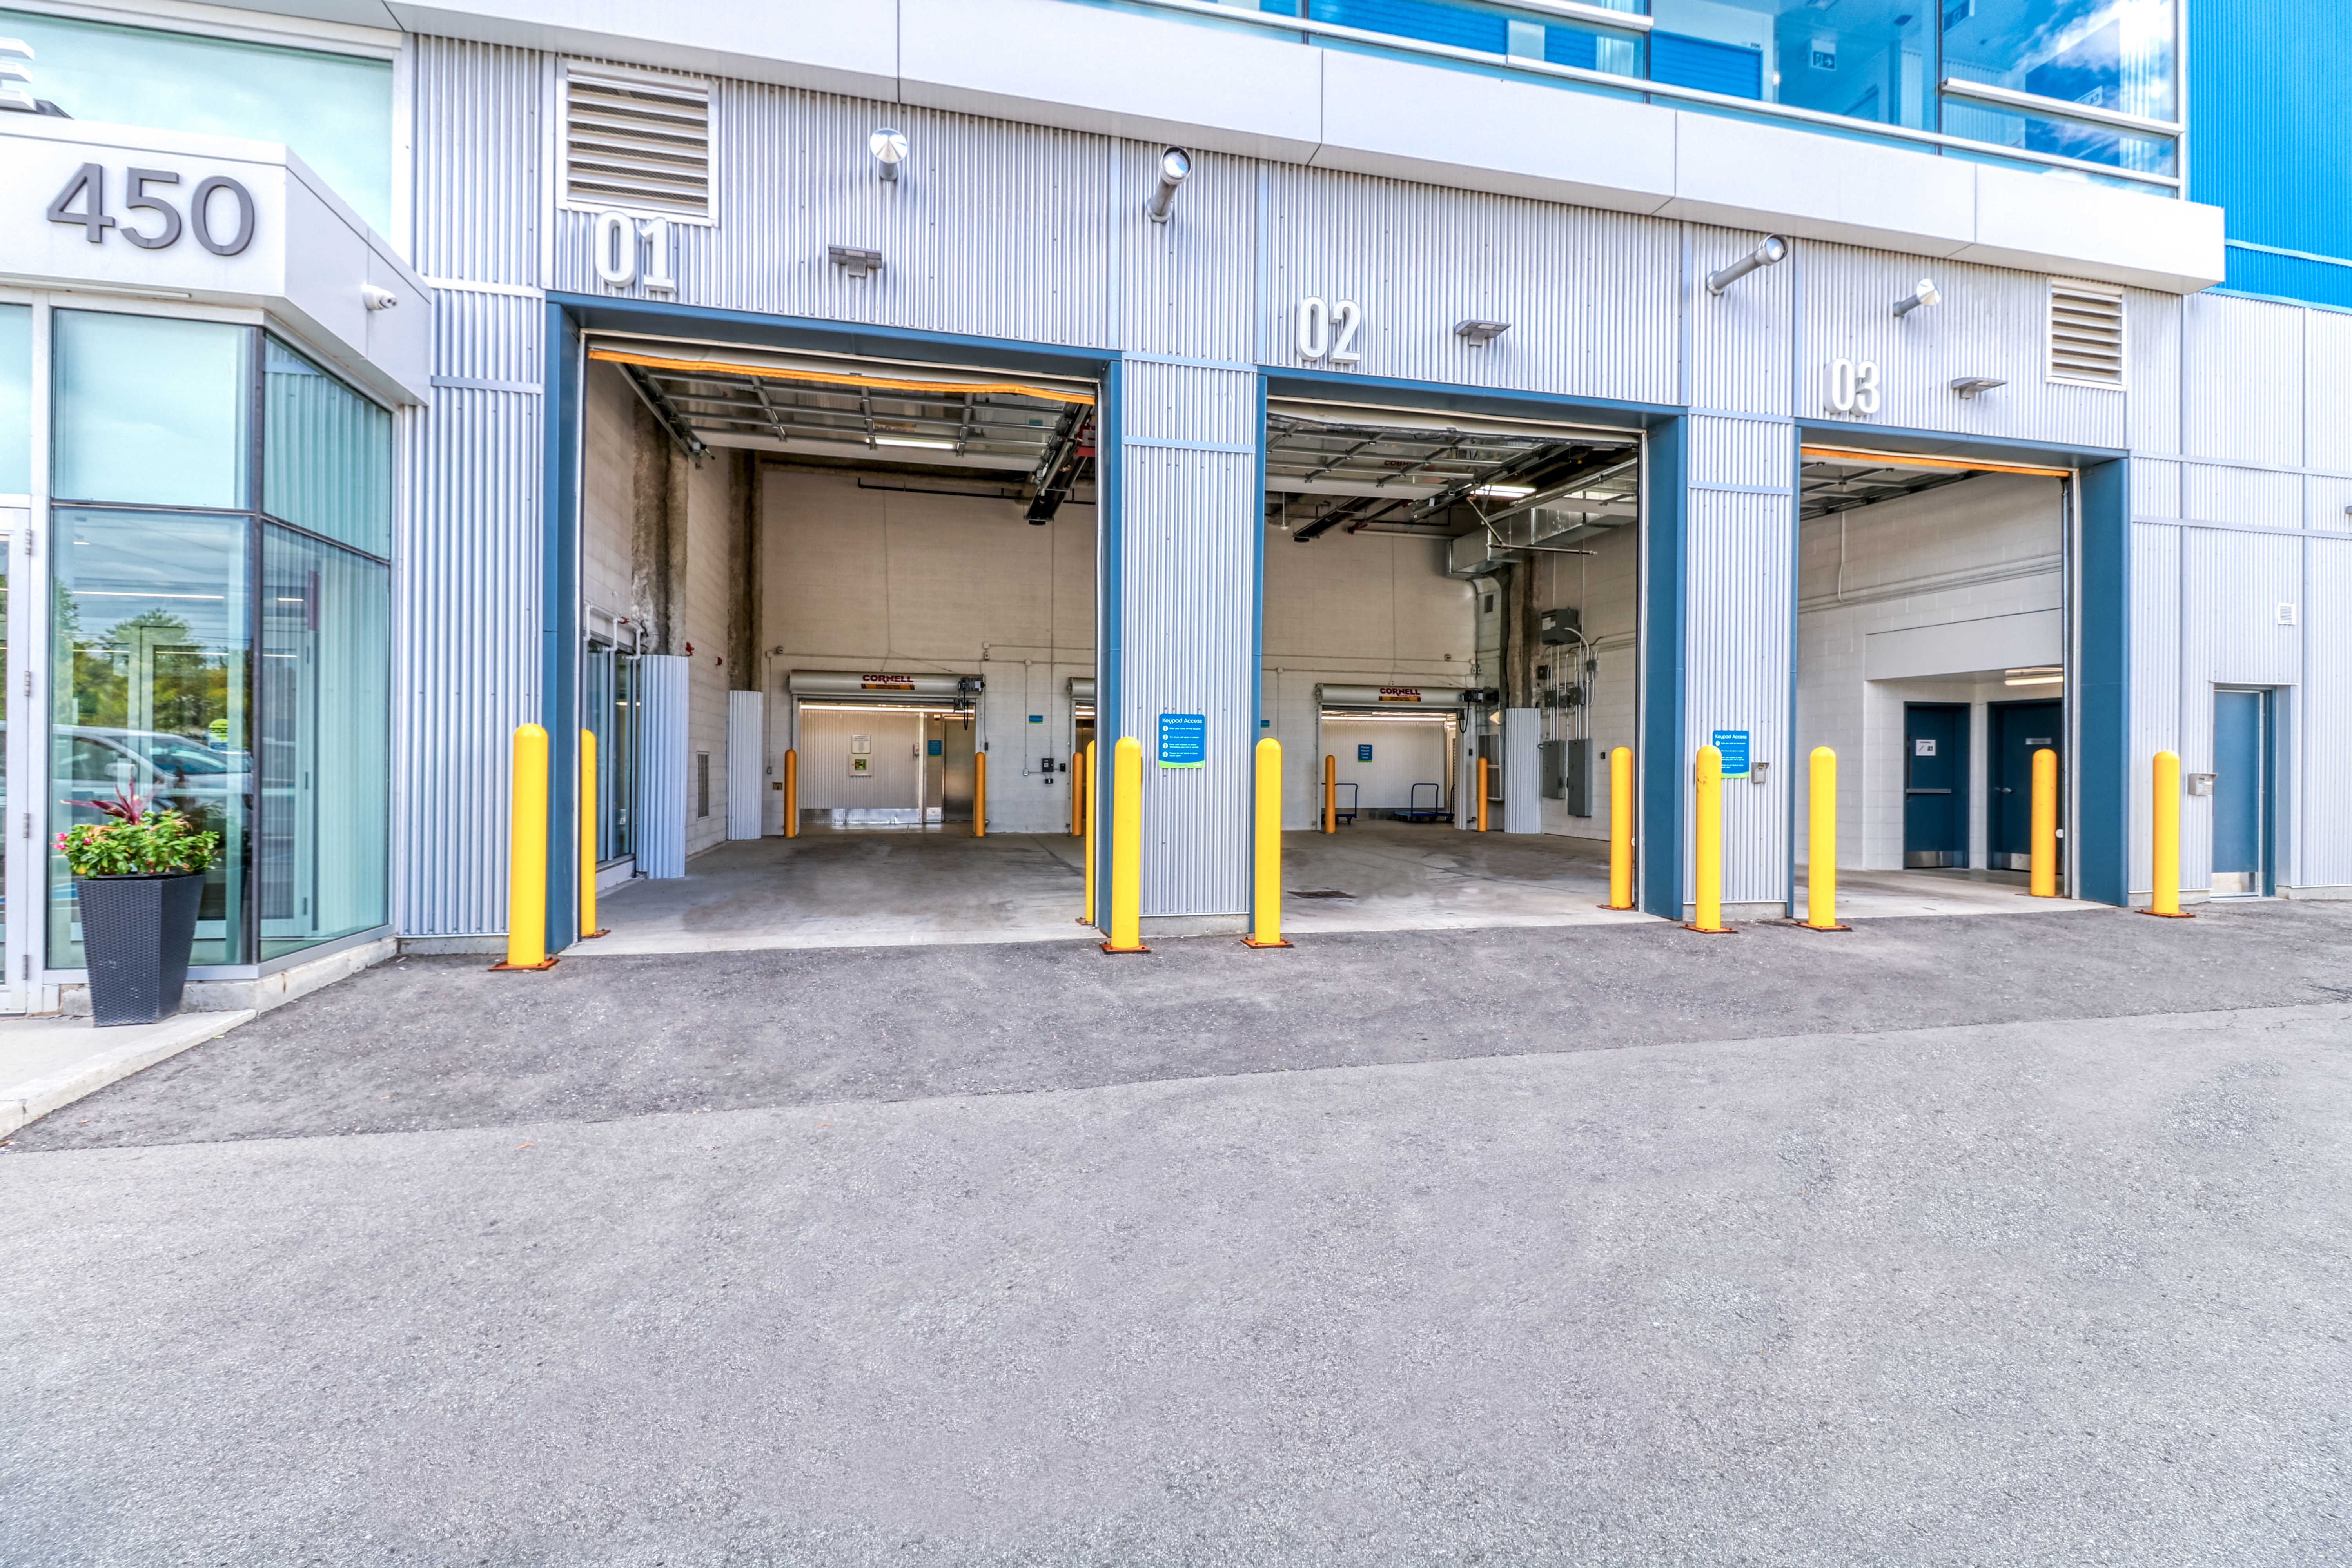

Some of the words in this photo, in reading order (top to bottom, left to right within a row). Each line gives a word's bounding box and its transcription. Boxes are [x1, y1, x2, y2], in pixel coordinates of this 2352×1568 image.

[46, 162, 254, 256] 450
[595, 210, 677, 293] 01
[1296, 296, 1361, 364] 02
[1824, 357, 1880, 416] 03
[862, 675, 914, 684] CORNELL
[1380, 688, 1420, 696] CORNELL
